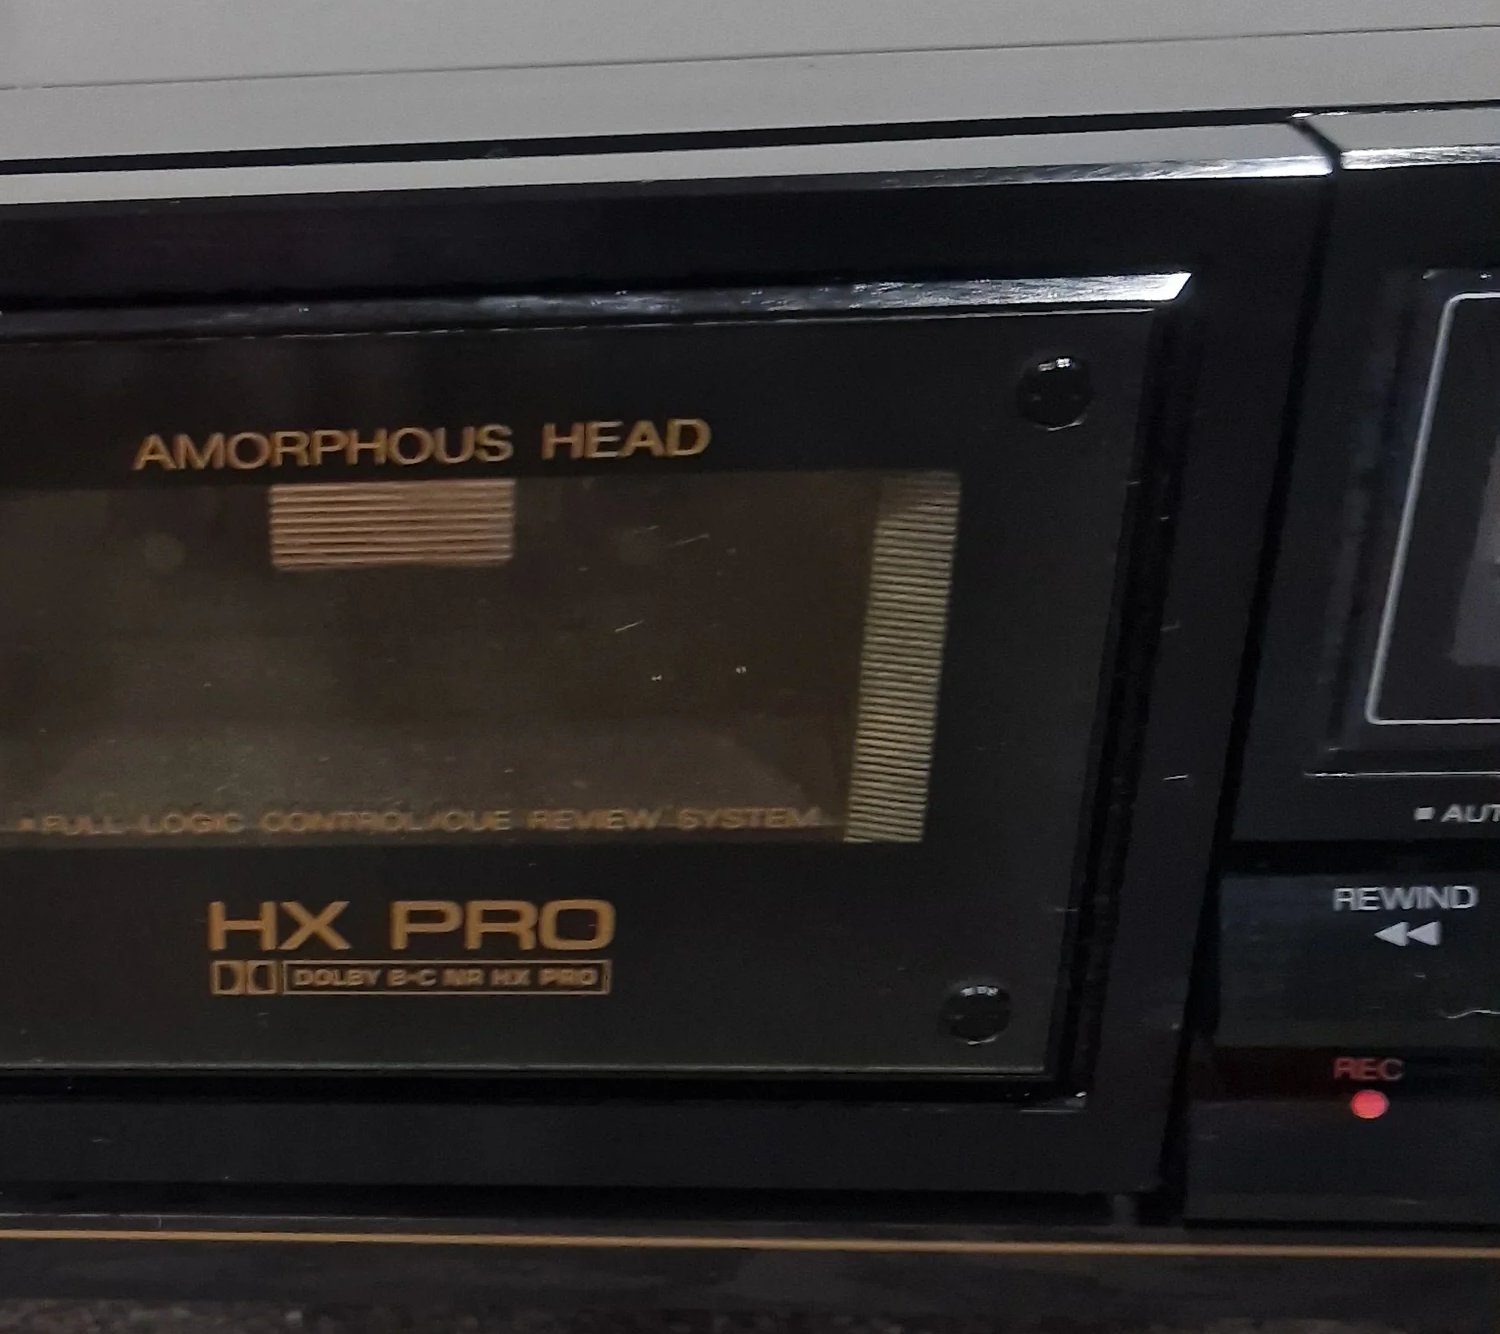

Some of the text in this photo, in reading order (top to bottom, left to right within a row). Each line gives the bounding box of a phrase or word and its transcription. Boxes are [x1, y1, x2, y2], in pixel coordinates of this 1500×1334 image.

[133, 418, 711, 471] AMORPHOUS HEAD
[141, 811, 246, 834] LOGIC
[527, 807, 662, 832] REVIEW
[675, 805, 822, 830] SYSTEM
[1332, 885, 1480, 912] REWIND
[208, 898, 617, 951] HX PRO
[292, 967, 381, 987] DOLBY
[538, 967, 599, 987] PRO
[1333, 1057, 1405, 1081] REC
